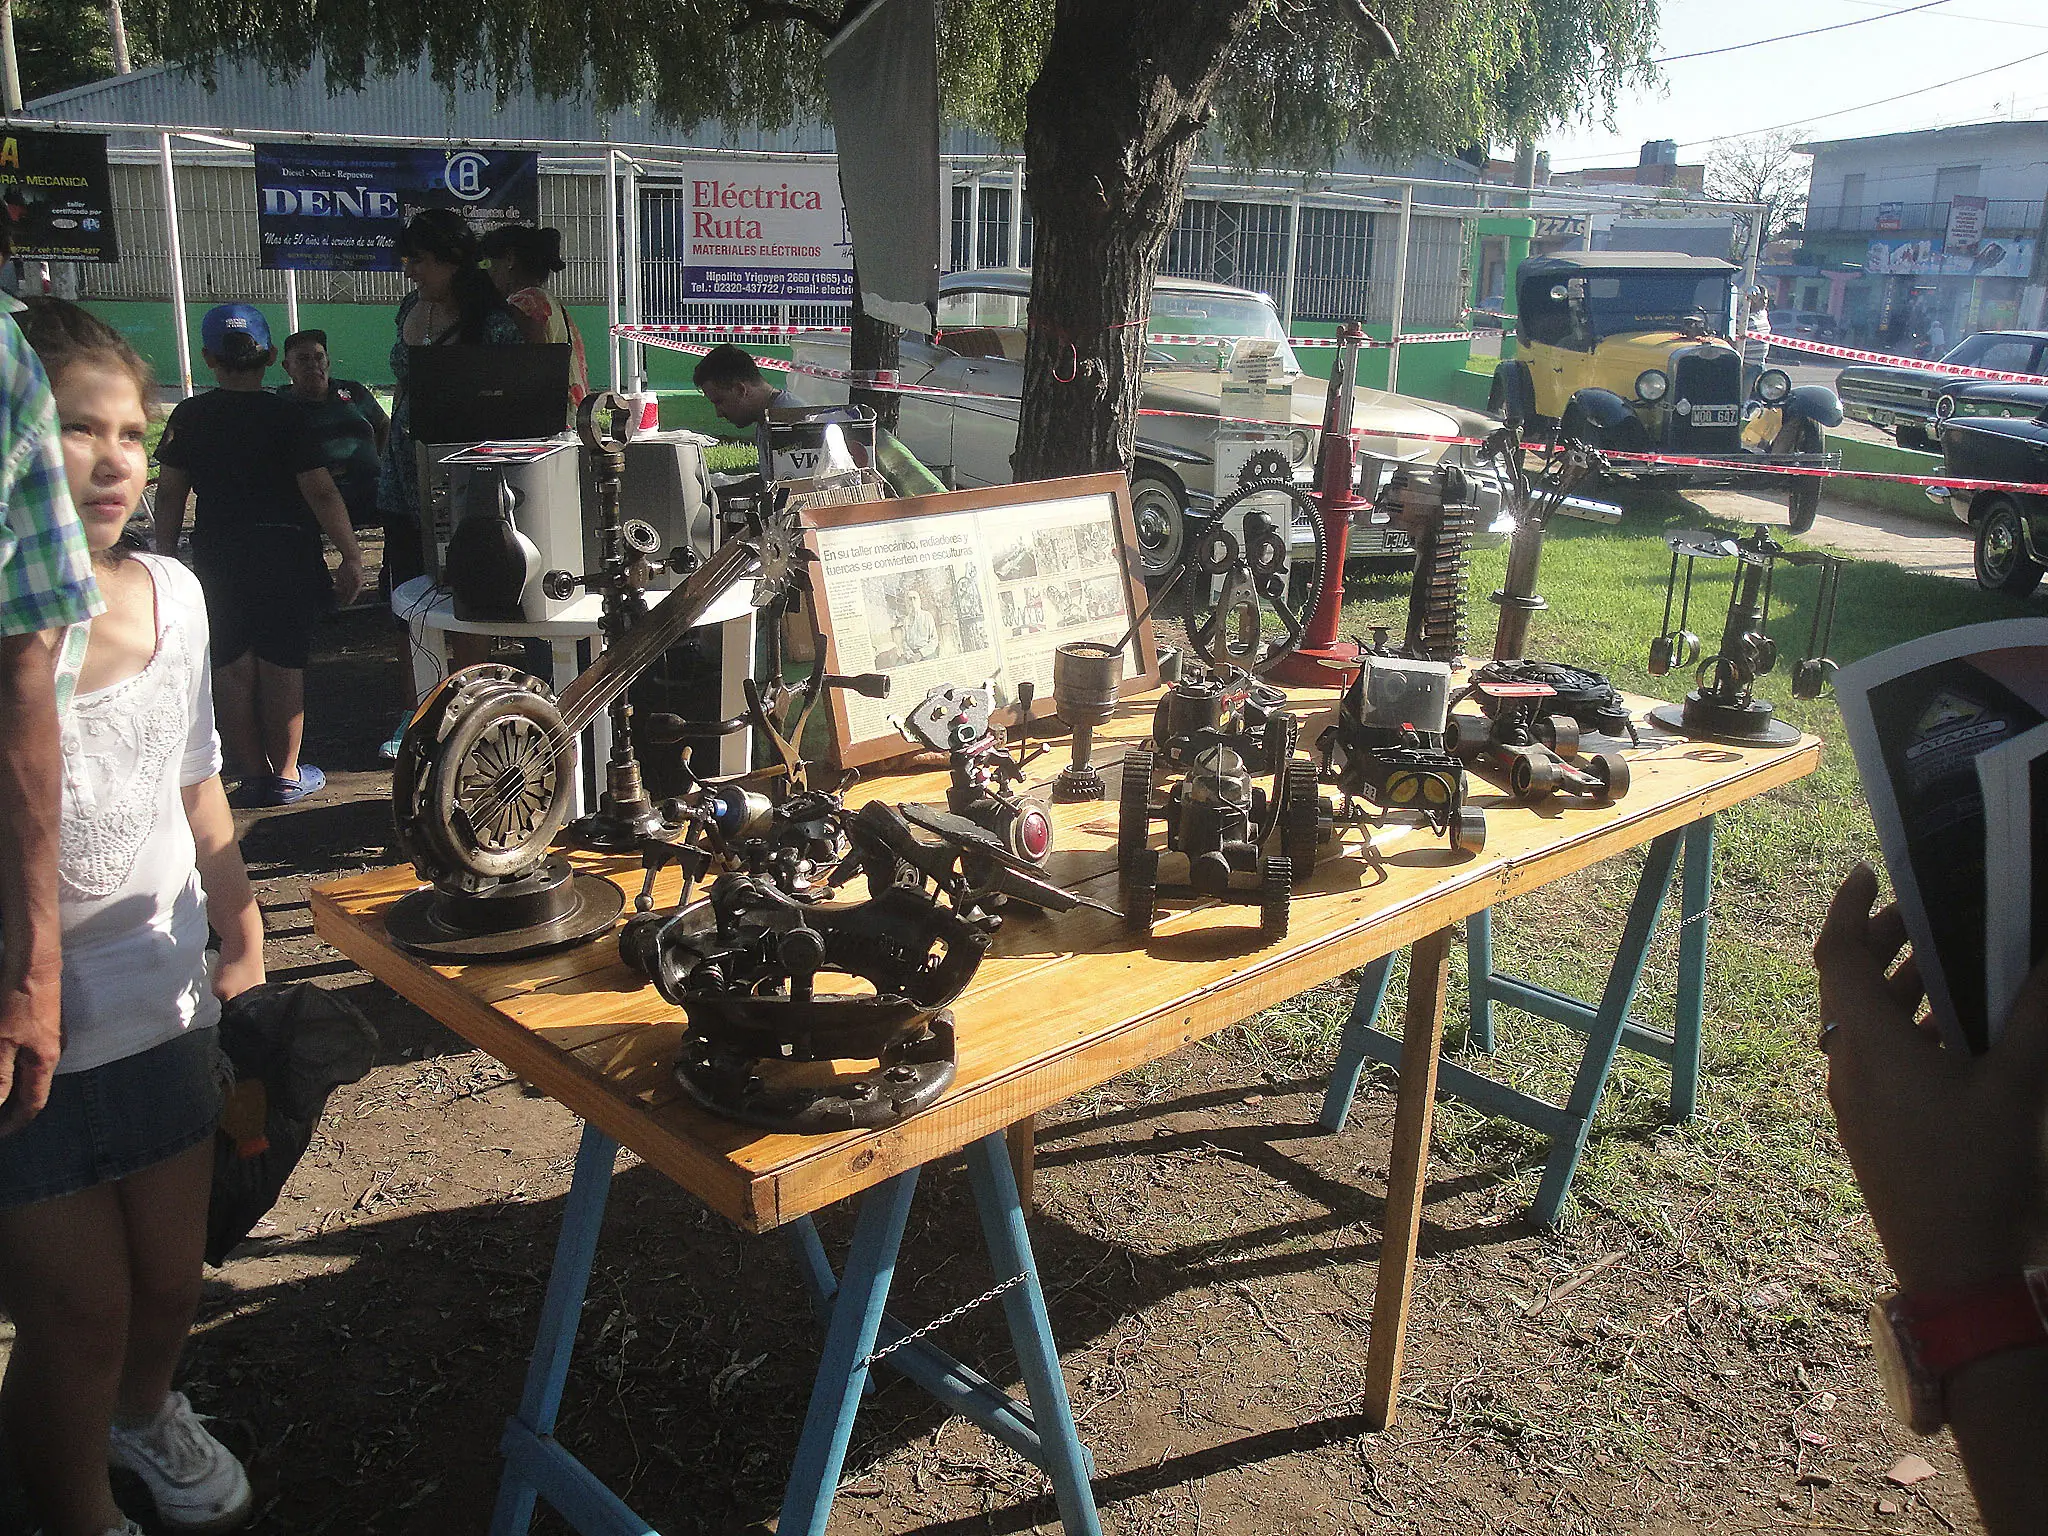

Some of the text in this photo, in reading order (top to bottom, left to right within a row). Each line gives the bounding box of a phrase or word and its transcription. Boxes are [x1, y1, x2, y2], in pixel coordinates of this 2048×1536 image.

[281, 167, 305, 177] Diesel
[310, 169, 331, 178] Nafta
[337, 170, 374, 181] Repuestos
[26, 176, 88, 187] MECANICA
[261, 186, 400, 218] DENE
[692, 180, 822, 210] Eléctrica
[505, 206, 520, 219] de
[692, 211, 763, 239] Ruta
[264, 232, 282, 245] Mas
[293, 234, 304, 245] 50
[305, 234, 320, 246] años
[330, 236, 355, 247] servicio
[692, 244, 822, 258] MATERIALES ELÉCTRICOS
[706, 271, 742, 283] Hipolito
[744, 271, 785, 284] Yrigoyen
[812, 273, 841, 284] (1665)
[714, 283, 779, 294] 02320-437722
[787, 285, 819, 295] e-mail:
[824, 549, 837, 562] En
[838, 549, 850, 560] su
[850, 546, 873, 558] taller
[874, 540, 918, 554] mecánico,
[919, 534, 963, 548] radiadores
[826, 546, 974, 577] tuercas se convierten en esculturas
